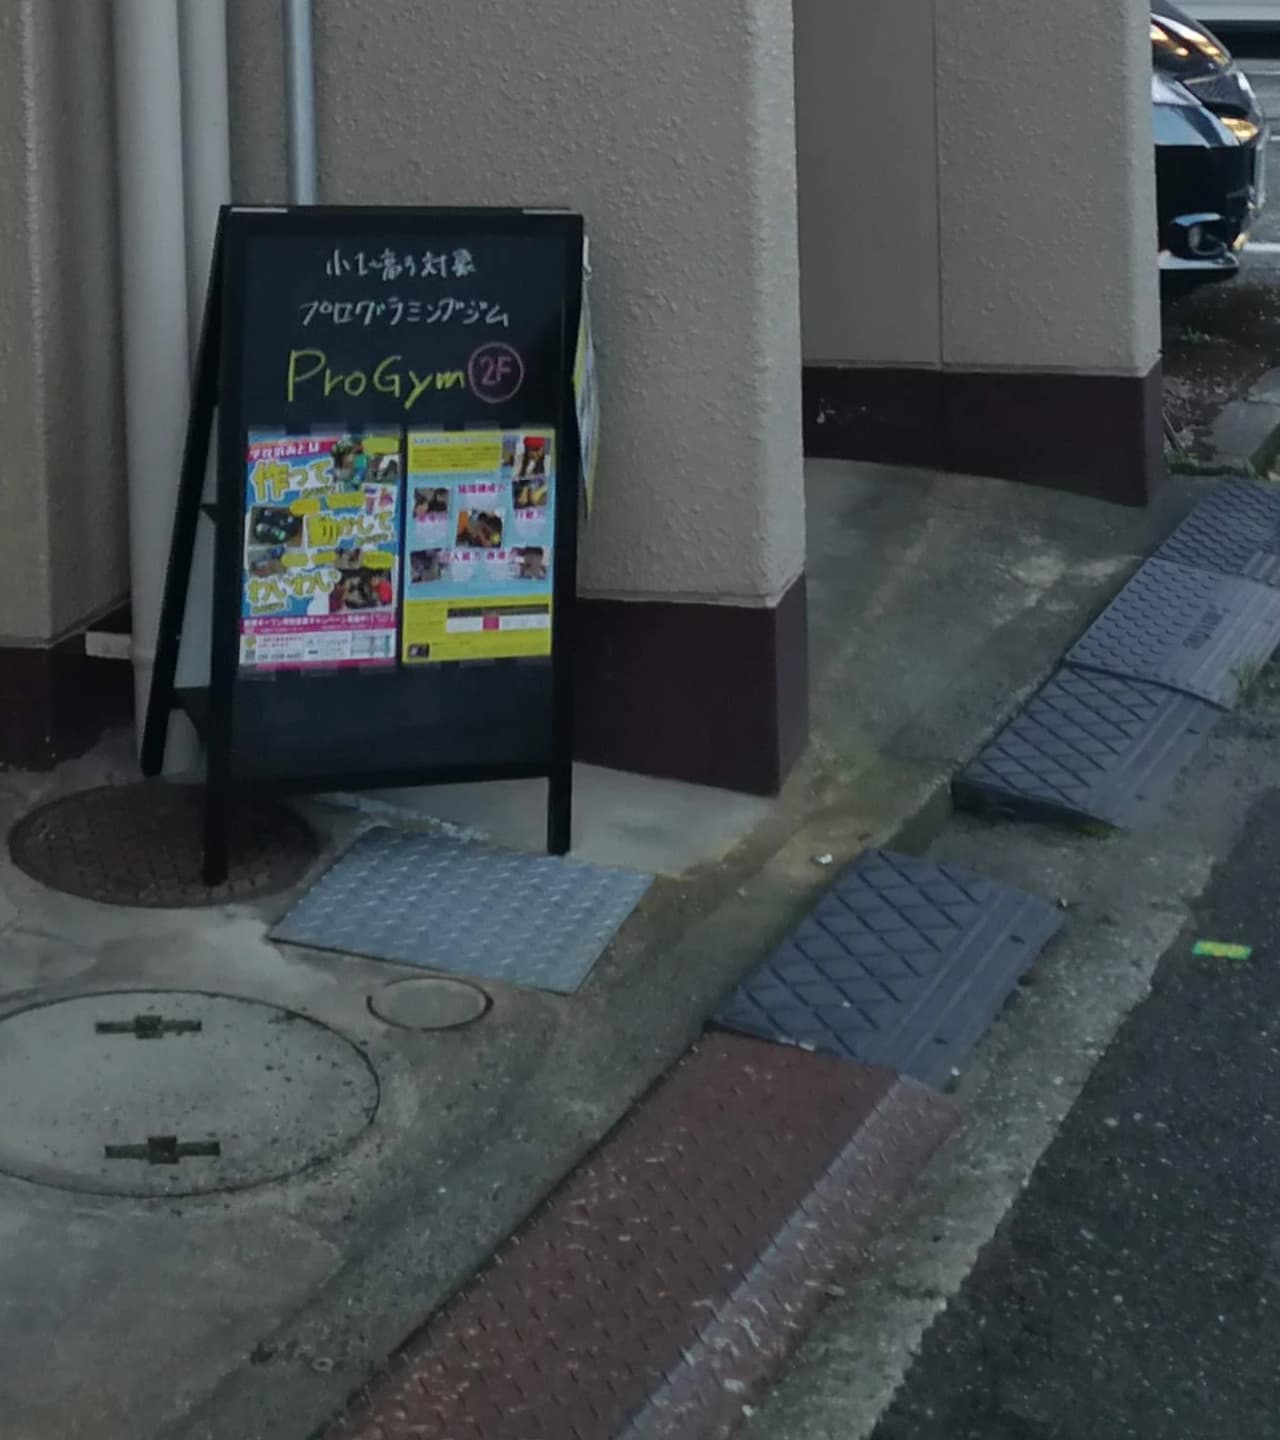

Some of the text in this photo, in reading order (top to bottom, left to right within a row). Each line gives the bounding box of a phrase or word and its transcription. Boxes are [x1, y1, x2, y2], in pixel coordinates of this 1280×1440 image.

[299, 296, 509, 327] プログラミングジム
[287, 349, 465, 410] ProGym
